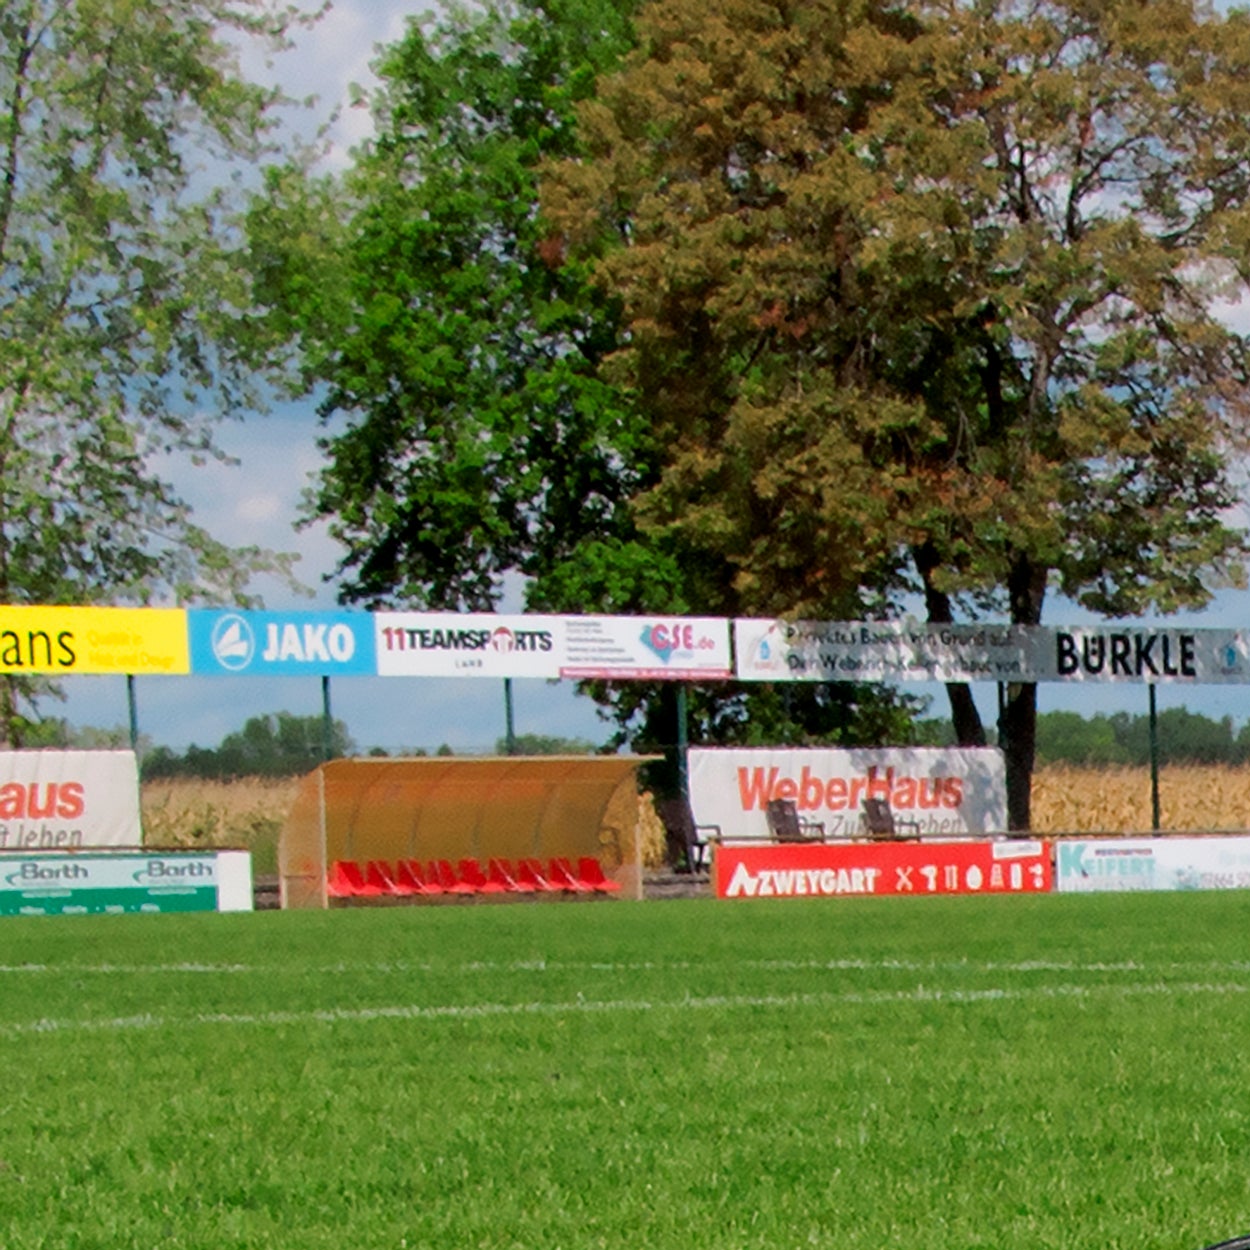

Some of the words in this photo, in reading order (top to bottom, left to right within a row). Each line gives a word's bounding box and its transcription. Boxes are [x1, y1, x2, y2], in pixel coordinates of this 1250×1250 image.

[262, 623, 356, 662] JAKO
[1056, 631, 1197, 677] BÜRKLE
[738, 766, 963, 812] WeberHaus
[21, 862, 88, 880] Barth
[148, 860, 212, 877] Barth
[756, 867, 877, 895] ZWEYGART
